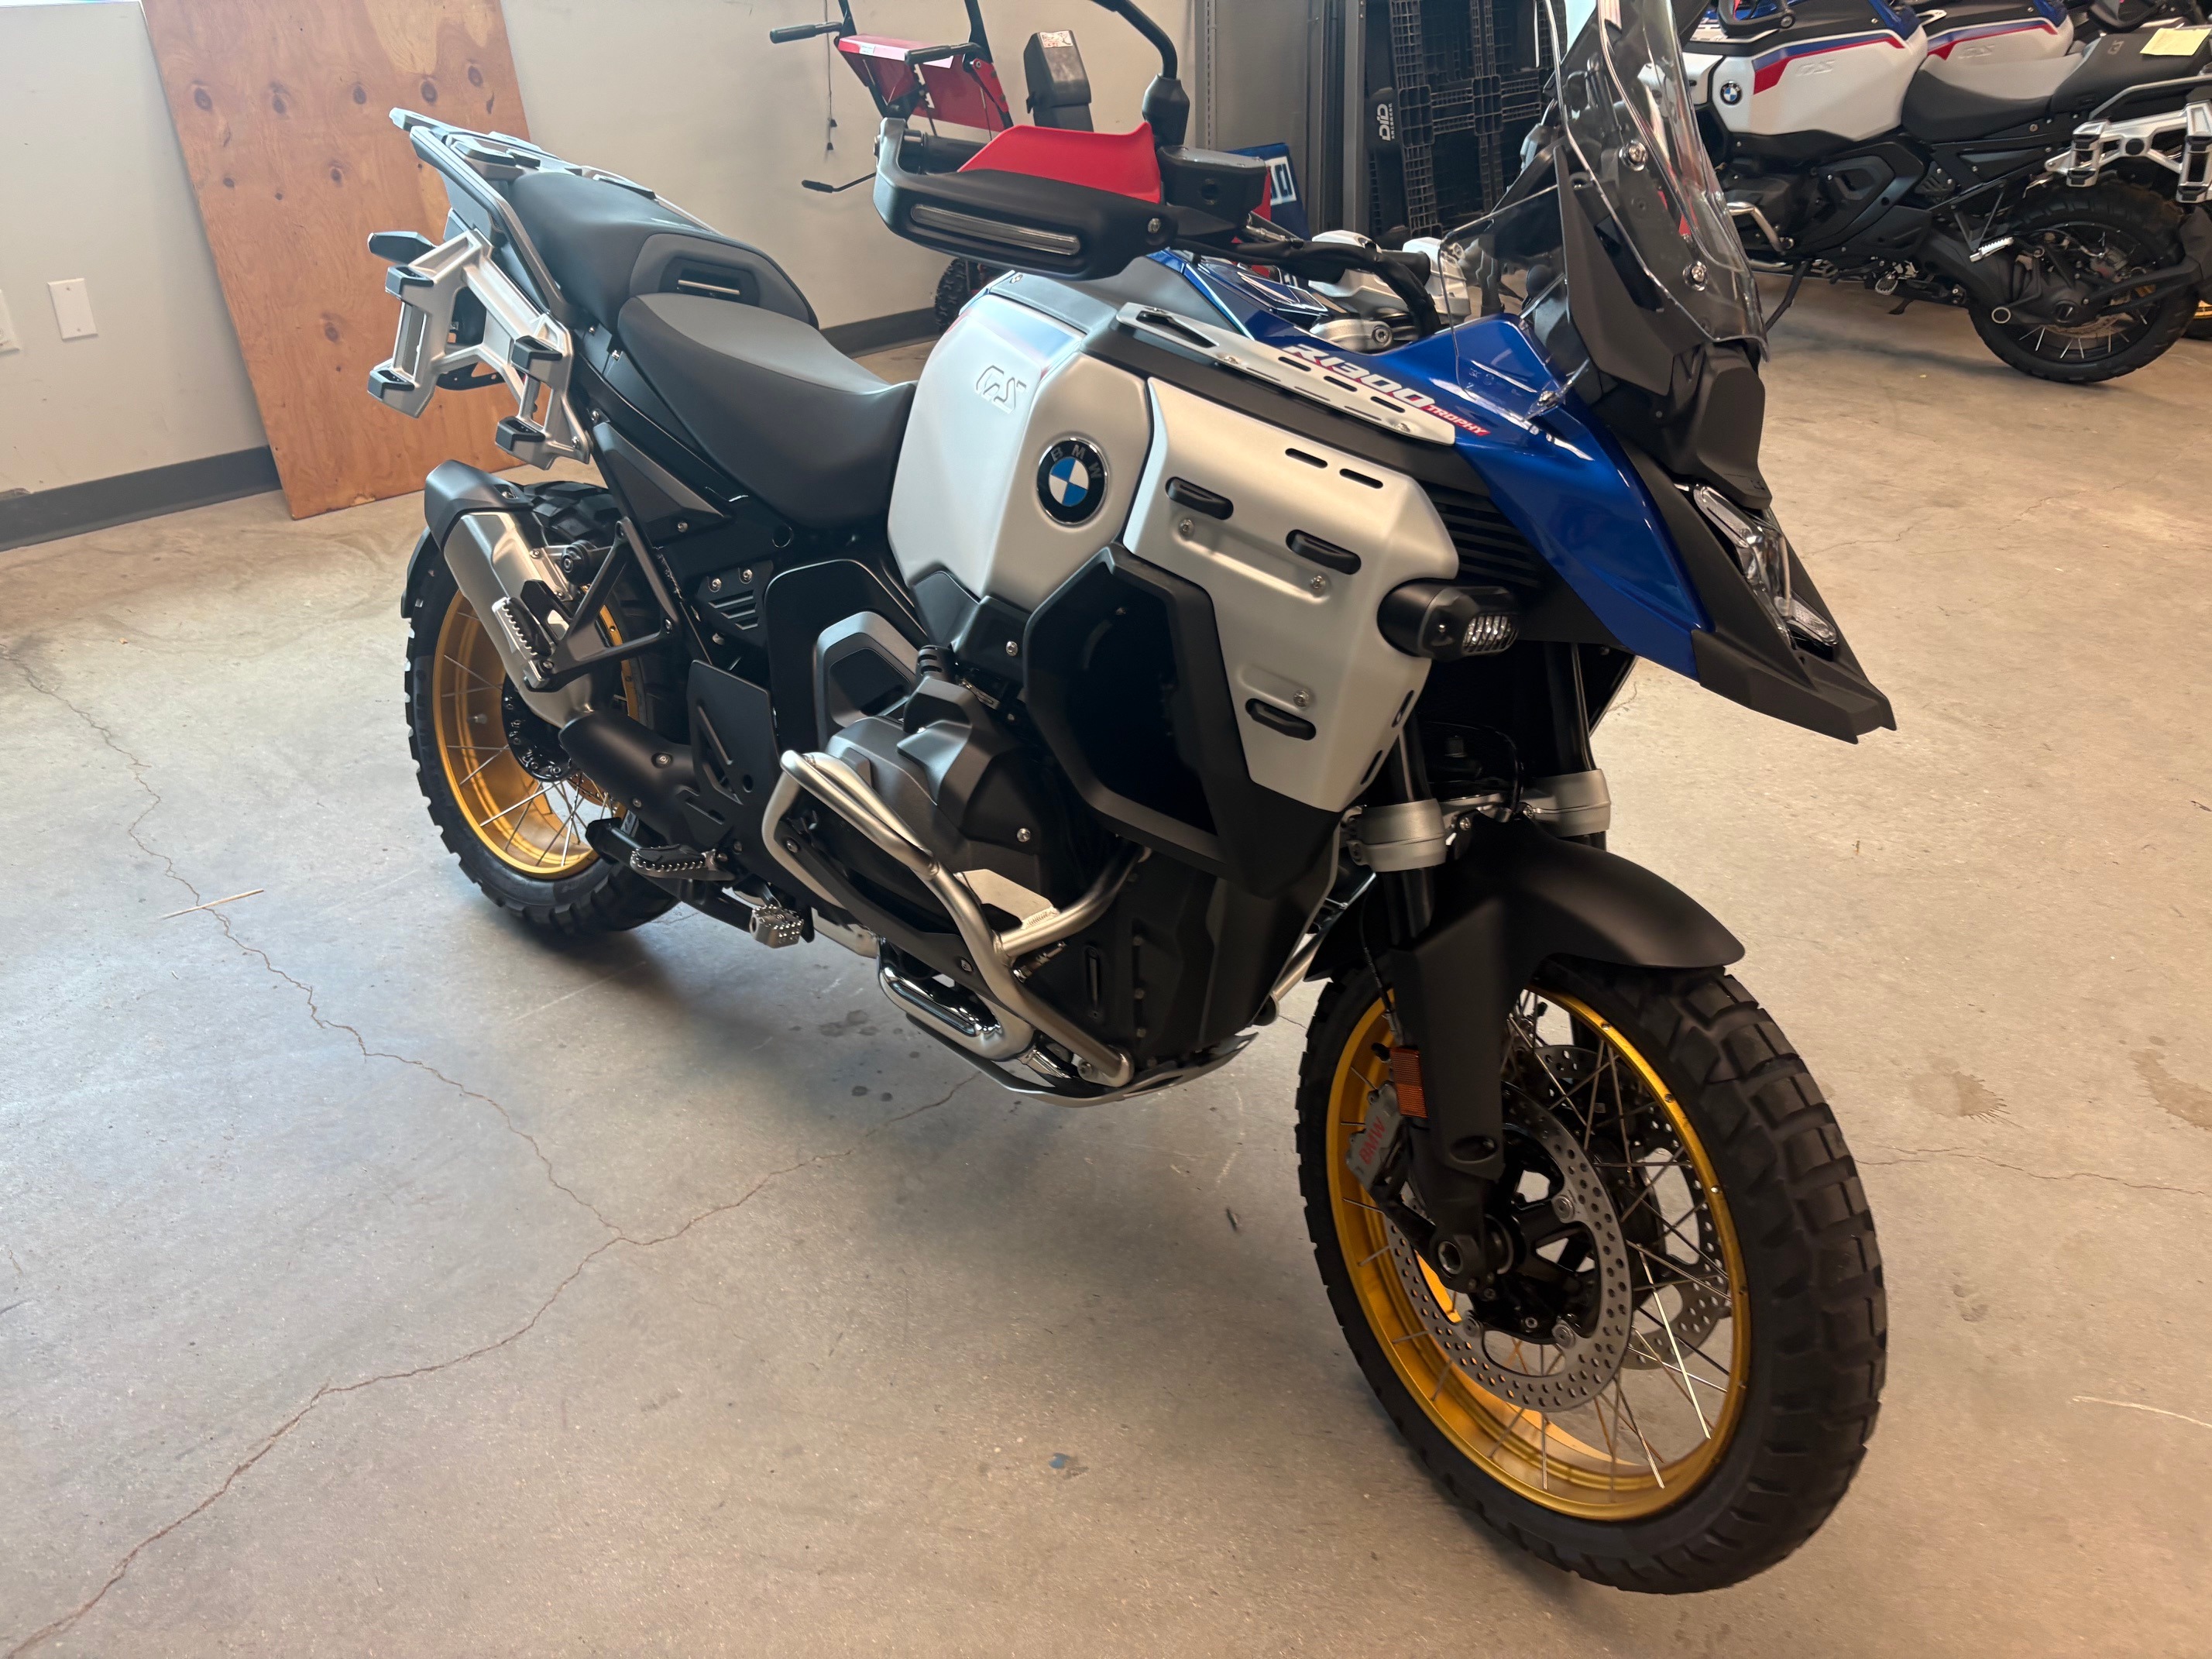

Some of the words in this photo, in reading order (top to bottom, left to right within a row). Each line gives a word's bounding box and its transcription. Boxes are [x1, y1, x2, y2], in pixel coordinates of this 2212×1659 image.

[1796, 59, 1836, 77] GS
[974, 364, 1027, 414] GS
[1282, 344, 1436, 408] R1300
[1425, 404, 1488, 435] TROPHY
[1050, 444, 1103, 479] BMW
[1358, 1115, 1386, 1166] BMW
